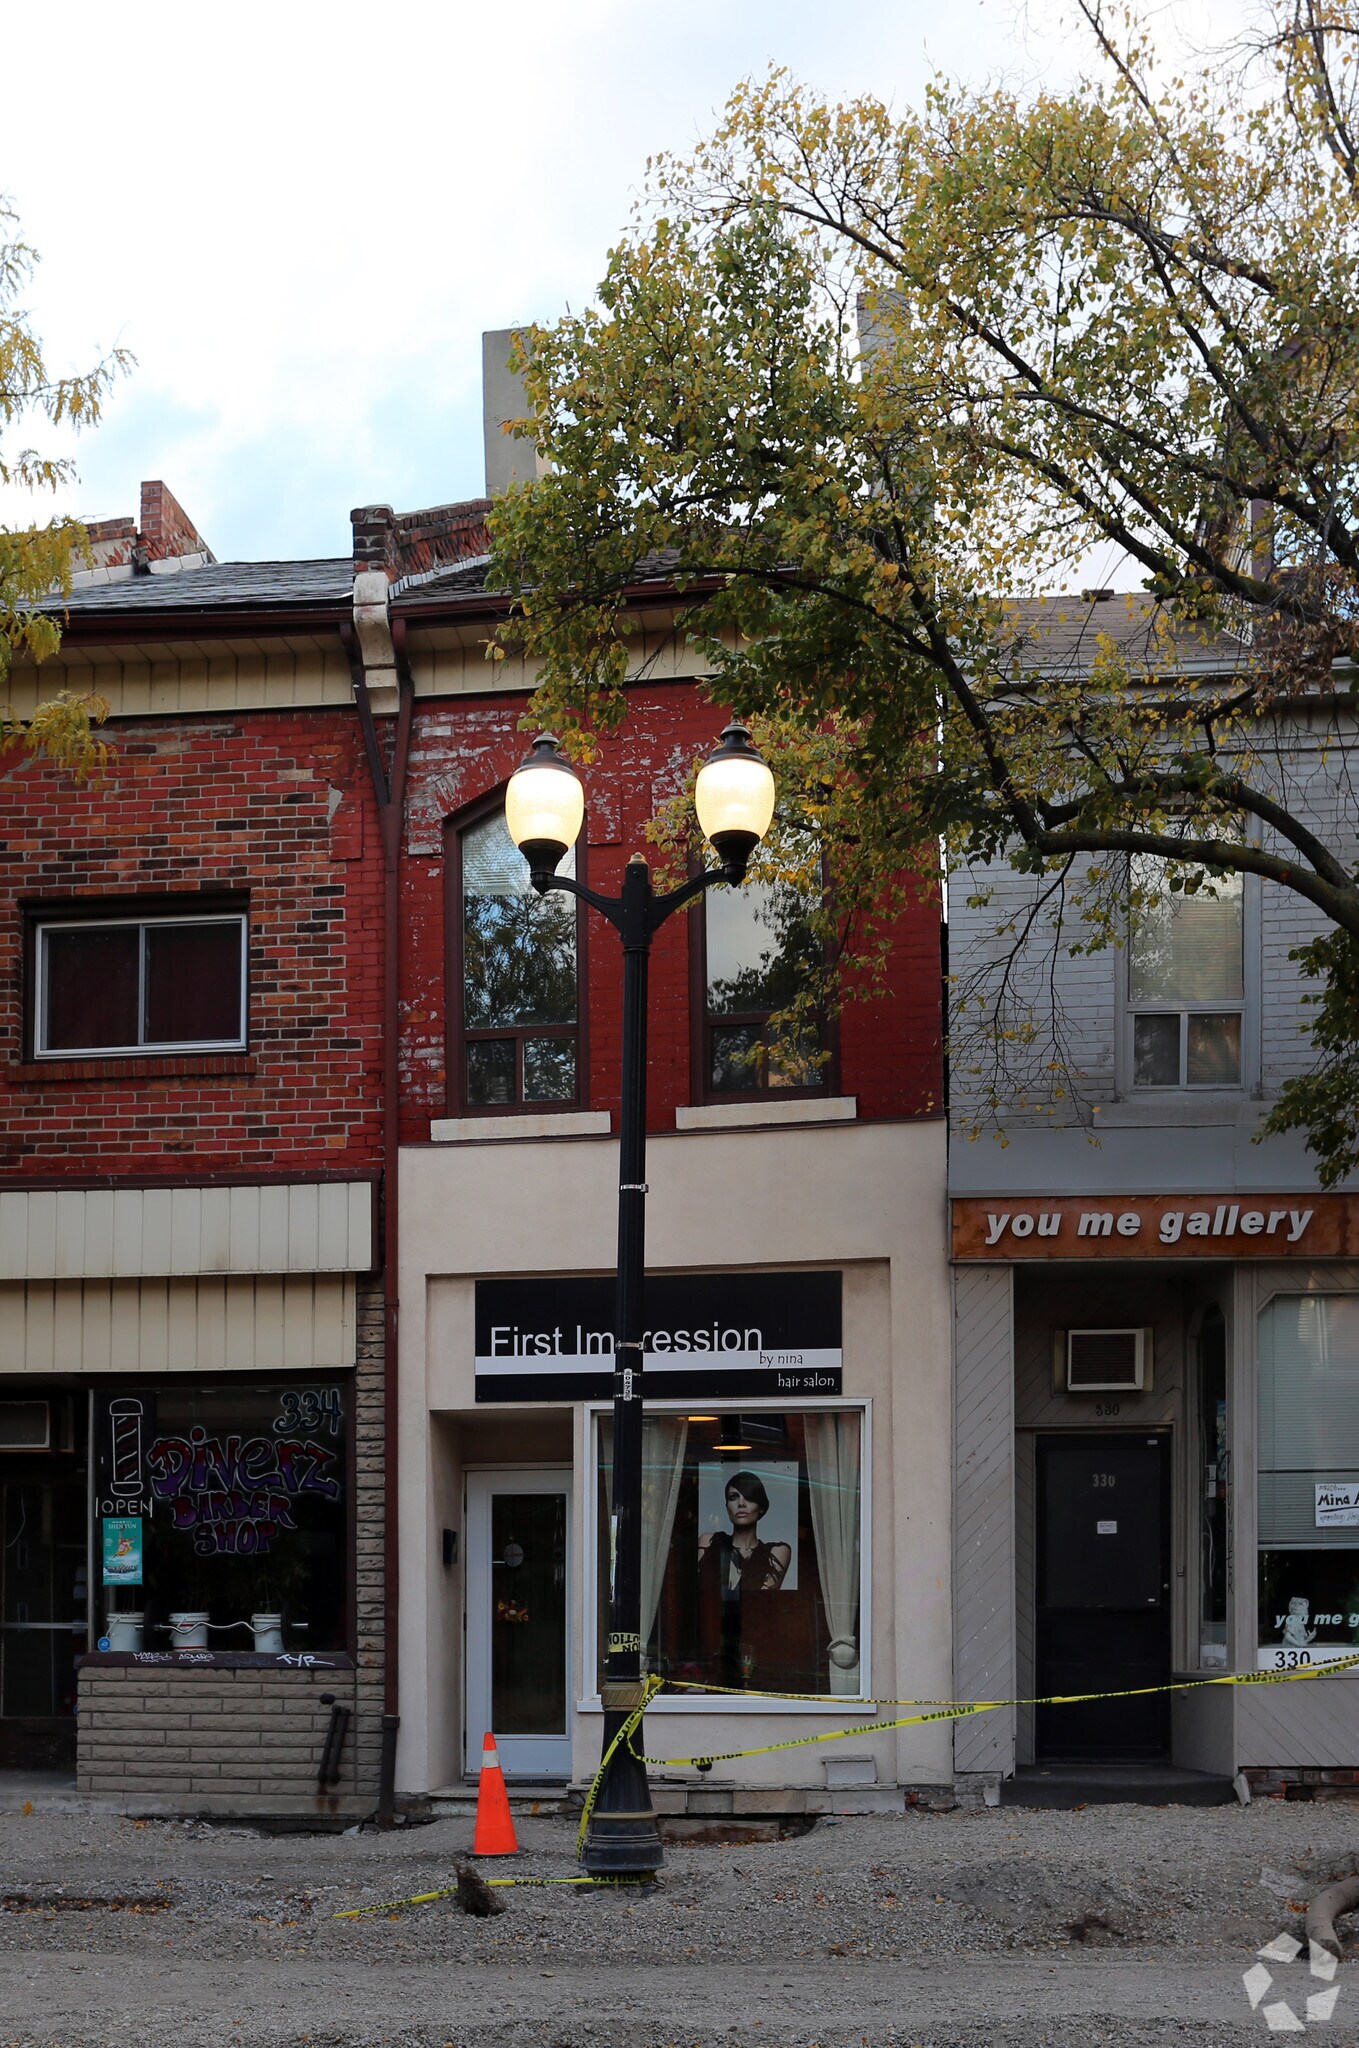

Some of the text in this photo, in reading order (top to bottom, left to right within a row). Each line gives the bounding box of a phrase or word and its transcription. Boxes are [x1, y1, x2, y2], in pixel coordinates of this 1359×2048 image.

[985, 1205, 1313, 1245] you me gallery
[490, 1321, 762, 1356] First Imression
[759, 1350, 803, 1368] by nina
[777, 1373, 835, 1388] hair salon
[273, 1388, 343, 1434] 334
[1092, 1473, 1116, 1487] 330
[101, 1499, 151, 1515] OPEN
[193, 1519, 278, 1555] SHOP
[1314, 1613, 1343, 1625] me
[1275, 1651, 1311, 1668] 330
